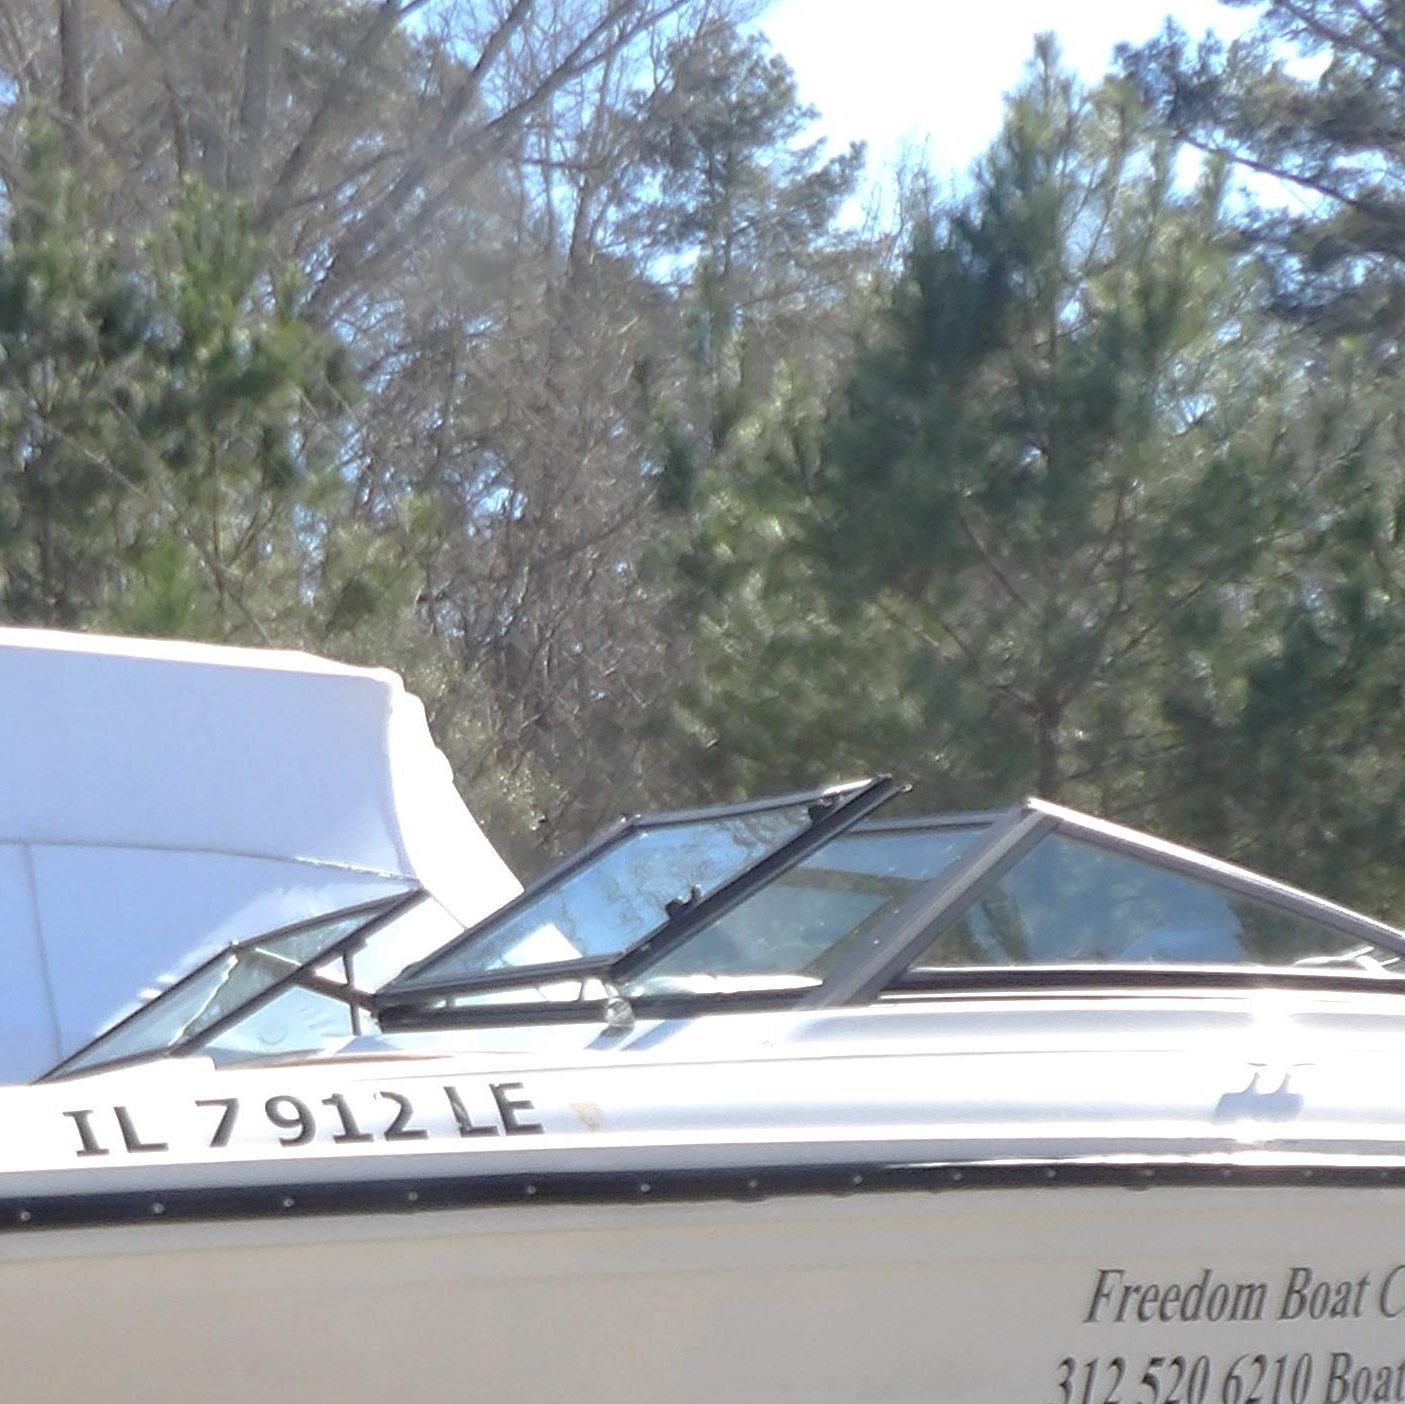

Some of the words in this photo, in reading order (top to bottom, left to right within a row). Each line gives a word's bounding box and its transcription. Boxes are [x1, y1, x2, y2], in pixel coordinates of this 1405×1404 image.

[63, 1105, 169, 1157] IL
[195, 1089, 429, 1149] 7912
[443, 1081, 545, 1138] LE
[1083, 1268, 1269, 1324] Freedom
[1277, 1265, 1371, 1320] Boat
